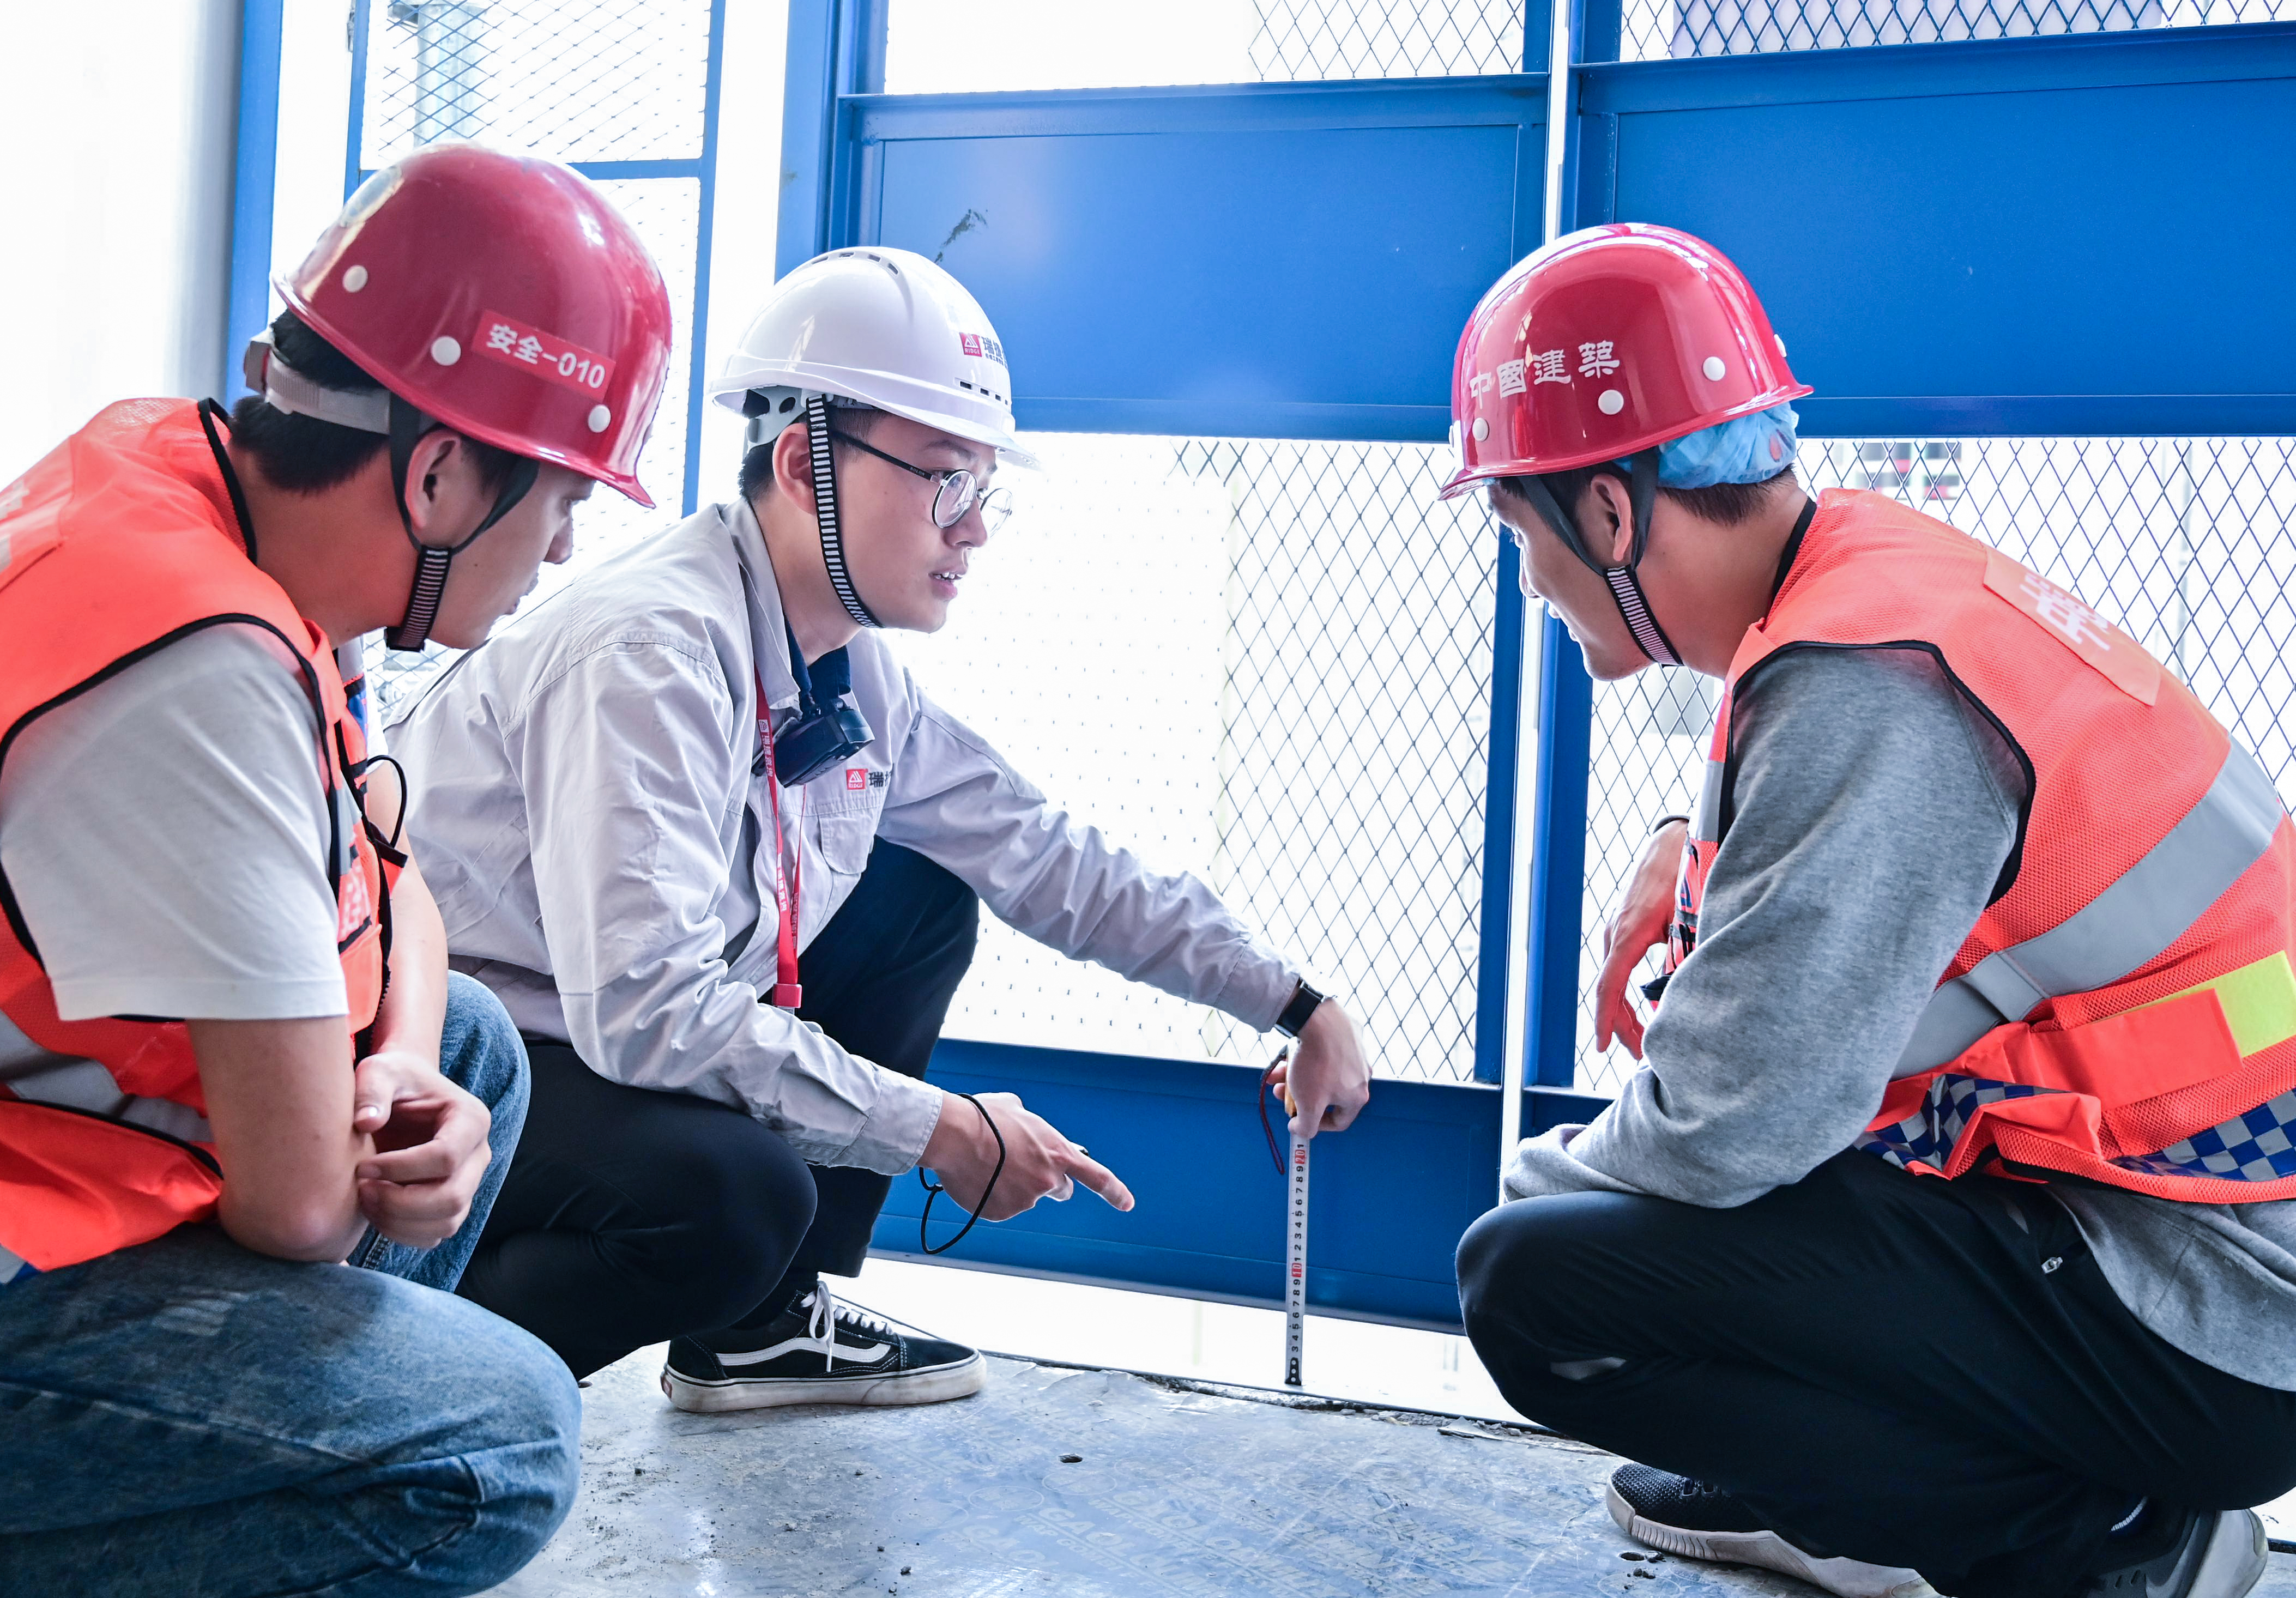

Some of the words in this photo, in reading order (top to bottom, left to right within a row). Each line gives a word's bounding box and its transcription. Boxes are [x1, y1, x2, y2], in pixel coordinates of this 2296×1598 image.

[486, 324, 605, 389] 安全-010
[1295, 1149, 1305, 1163] 20
[1292, 1263, 1301, 1276] 10
